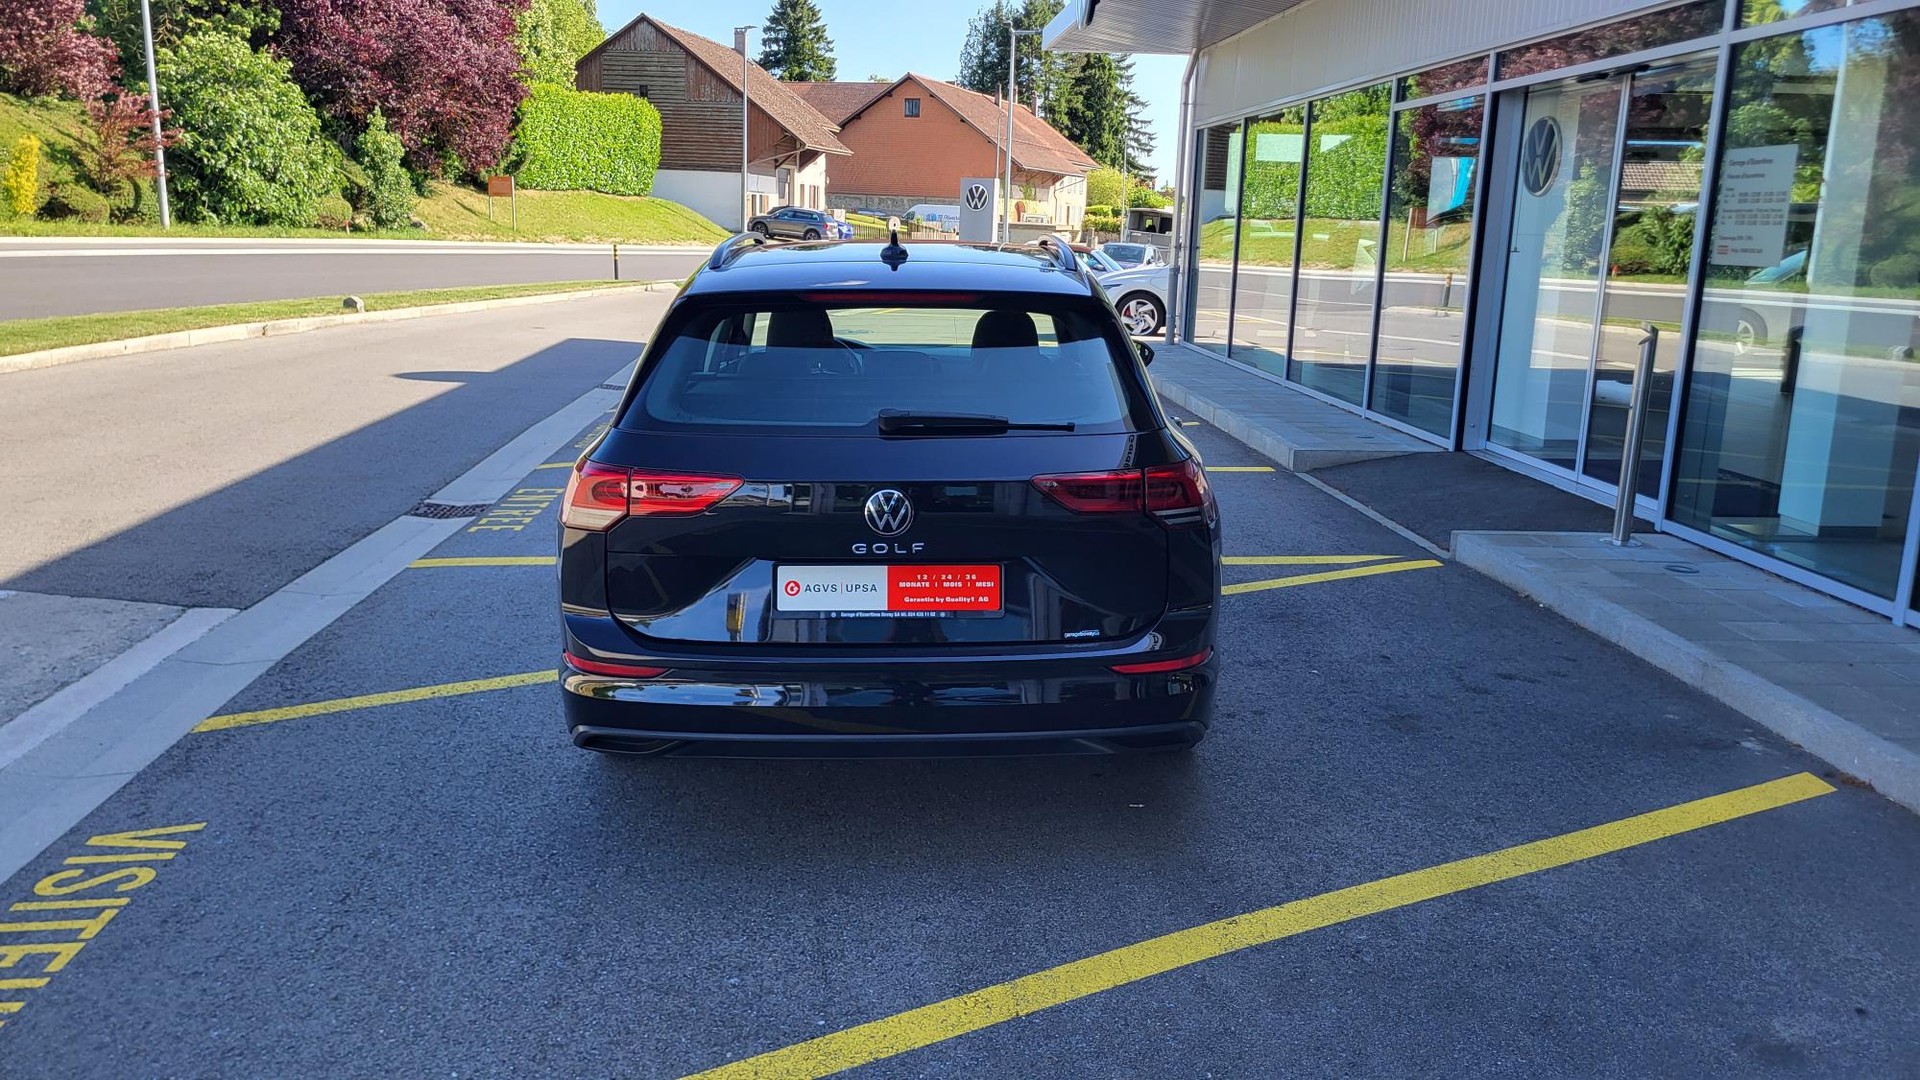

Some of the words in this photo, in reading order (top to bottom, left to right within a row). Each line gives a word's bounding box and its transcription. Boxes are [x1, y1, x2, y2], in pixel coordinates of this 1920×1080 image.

[851, 542, 925, 554] GOLF
[804, 583, 838, 593] AGVS
[845, 583, 878, 593] UPSA
